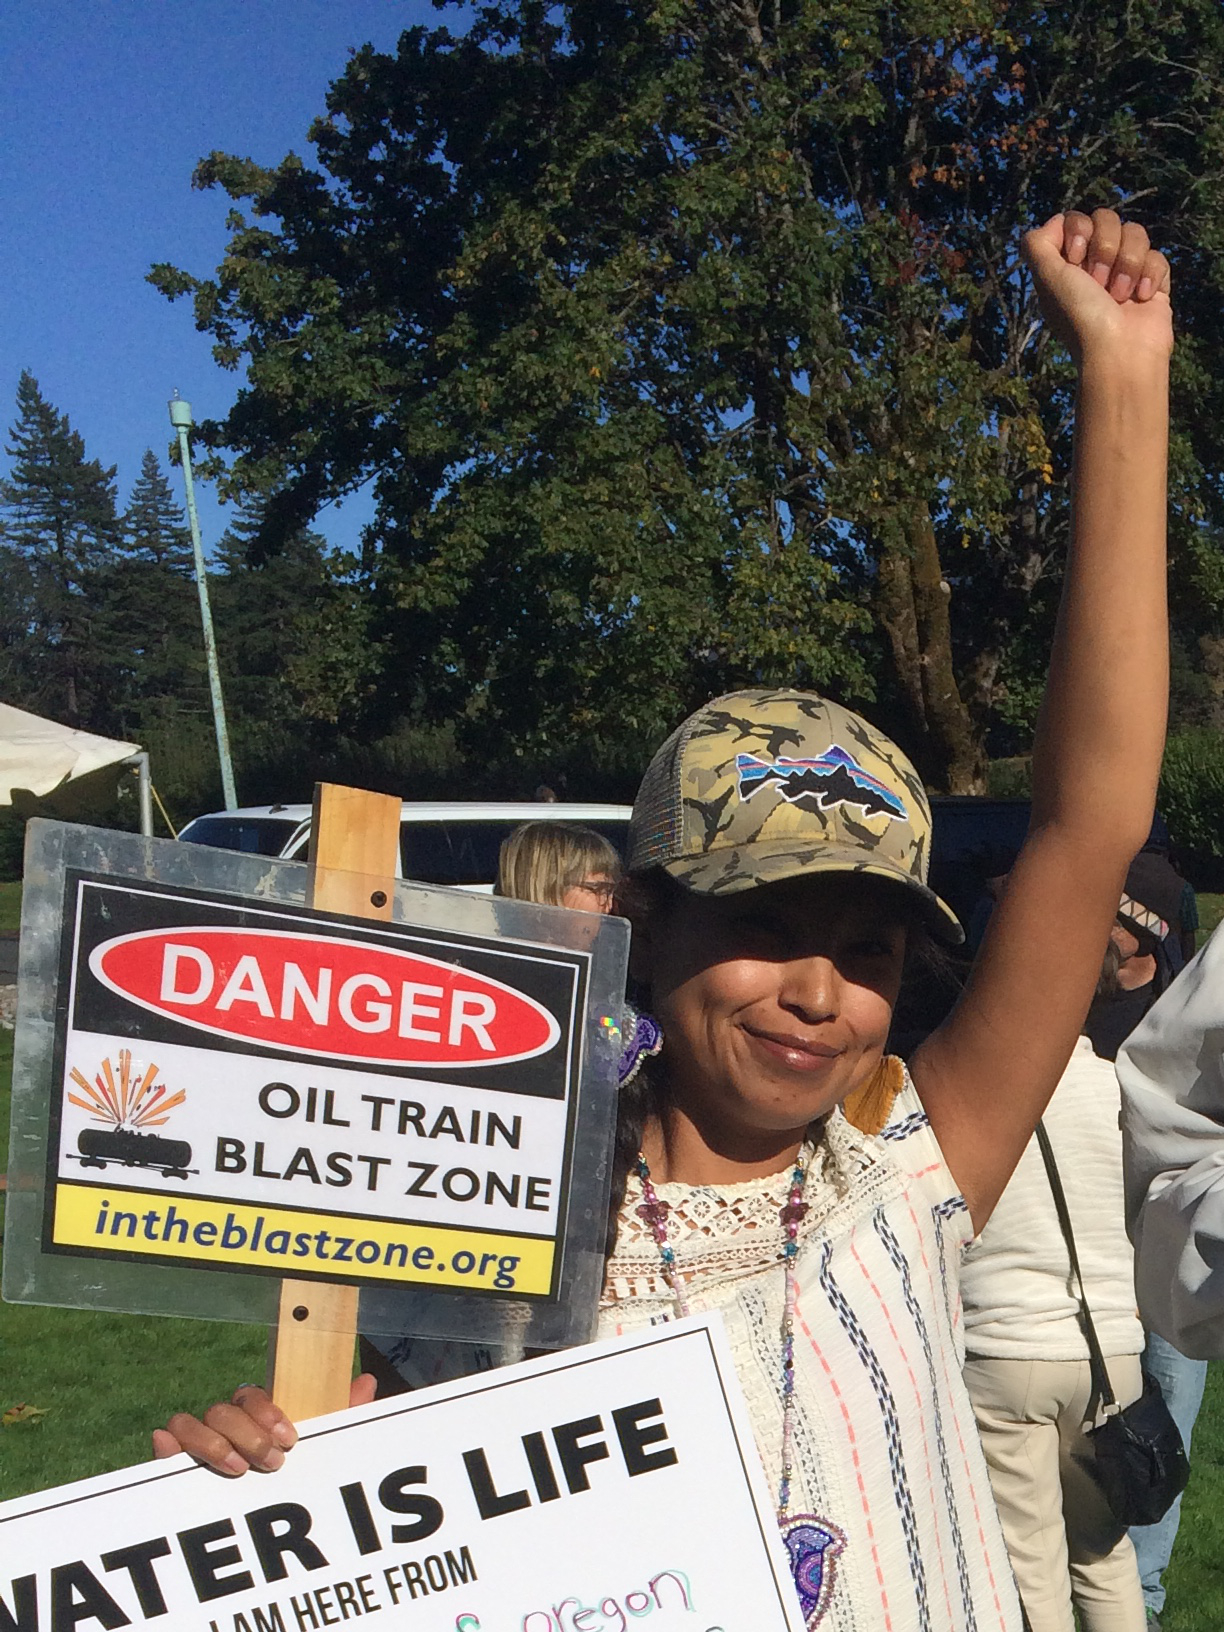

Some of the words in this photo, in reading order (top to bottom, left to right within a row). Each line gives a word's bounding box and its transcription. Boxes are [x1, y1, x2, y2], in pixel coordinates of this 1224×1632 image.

[159, 943, 497, 1052] DANGER
[258, 1082, 350, 1129] OIL
[362, 1094, 523, 1149] TRAIN
[215, 1136, 389, 1191] BLAST
[405, 1163, 551, 1212] ZONE
[94, 1200, 520, 1289] intheblastzone.org
[339, 1465, 444, 1556] IS
[462, 1398, 679, 1521] LIFE
[383, 1546, 478, 1605] FROM
